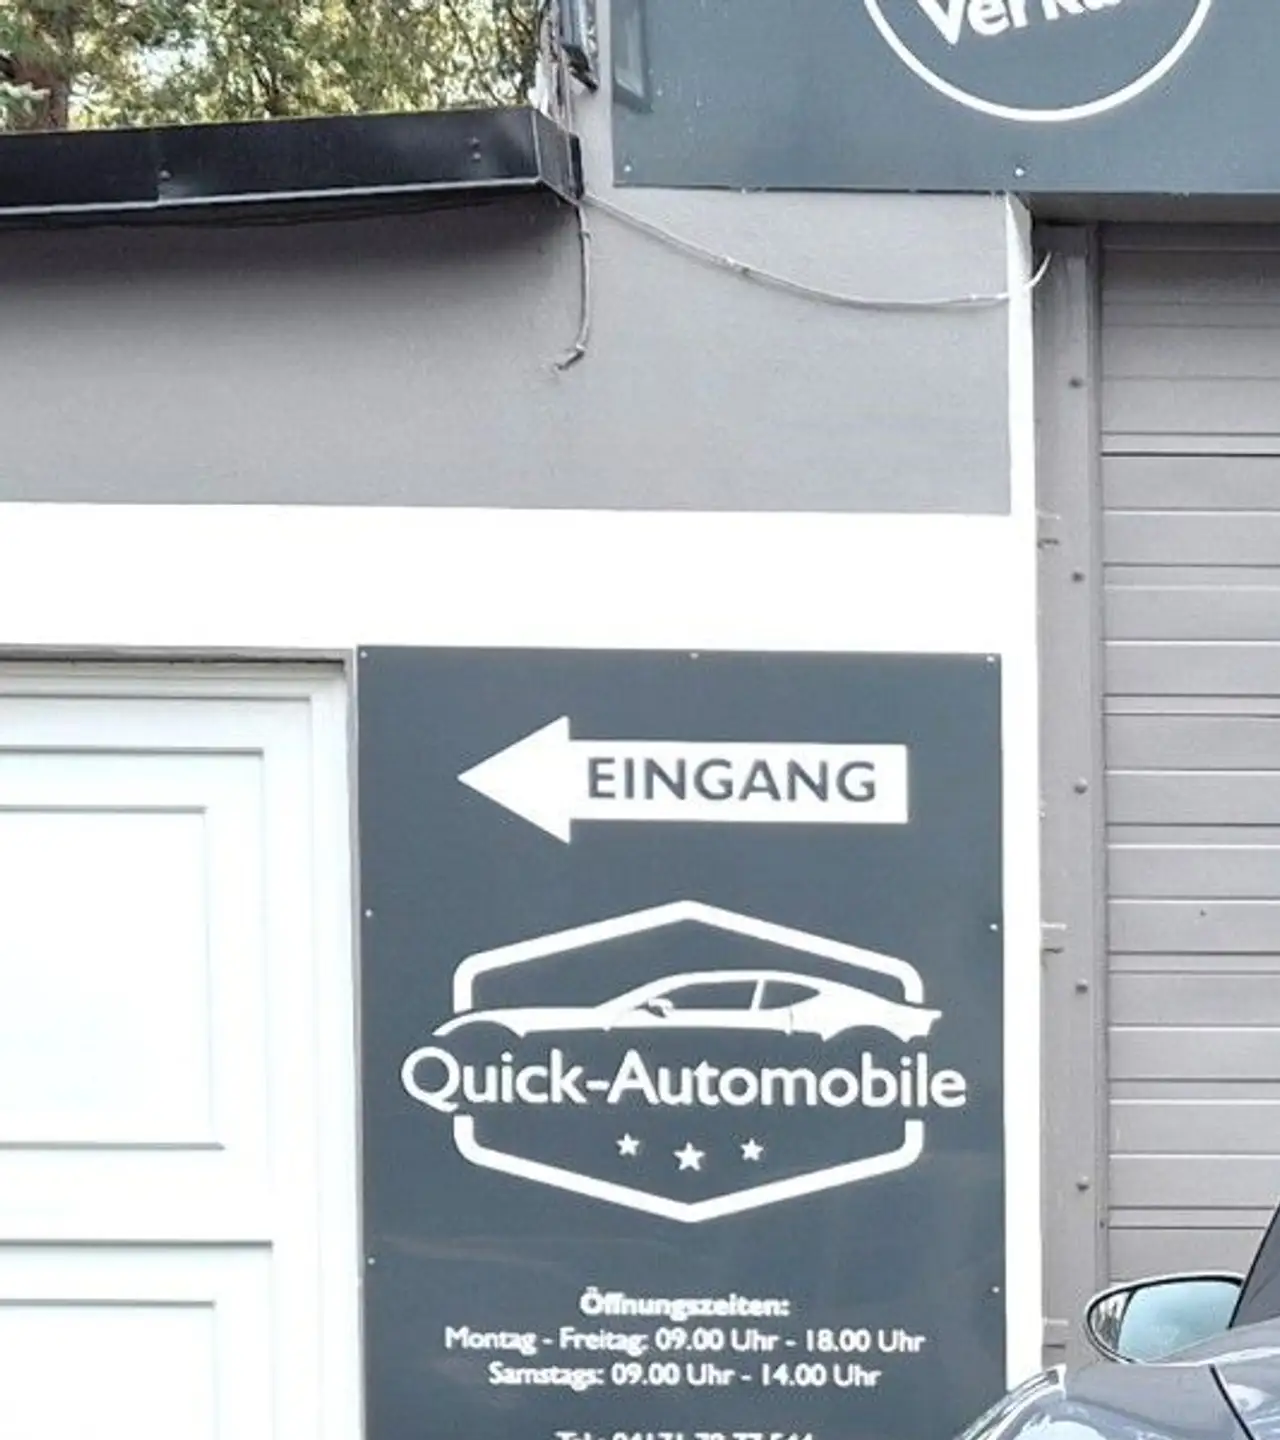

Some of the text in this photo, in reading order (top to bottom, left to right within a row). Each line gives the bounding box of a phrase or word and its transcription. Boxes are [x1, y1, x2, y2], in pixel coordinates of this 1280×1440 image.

[588, 757, 877, 803] EINGANG
[401, 1045, 967, 1113] Quick-Automobile
[580, 1286, 790, 1322] Öffnungszeiten:
[445, 1326, 538, 1356] Montag
[559, 1327, 649, 1357] Freitag:
[655, 1327, 725, 1351] 09.00
[730, 1328, 780, 1352] Uhr
[806, 1328, 872, 1353] 18.00
[878, 1329, 927, 1353] Uhr
[488, 1360, 605, 1391] Samstags:
[611, 1362, 681, 1386] 09.00
[686, 1363, 736, 1386] Uhr
[762, 1363, 827, 1387] 14.00
[833, 1363, 882, 1387] Uhr
